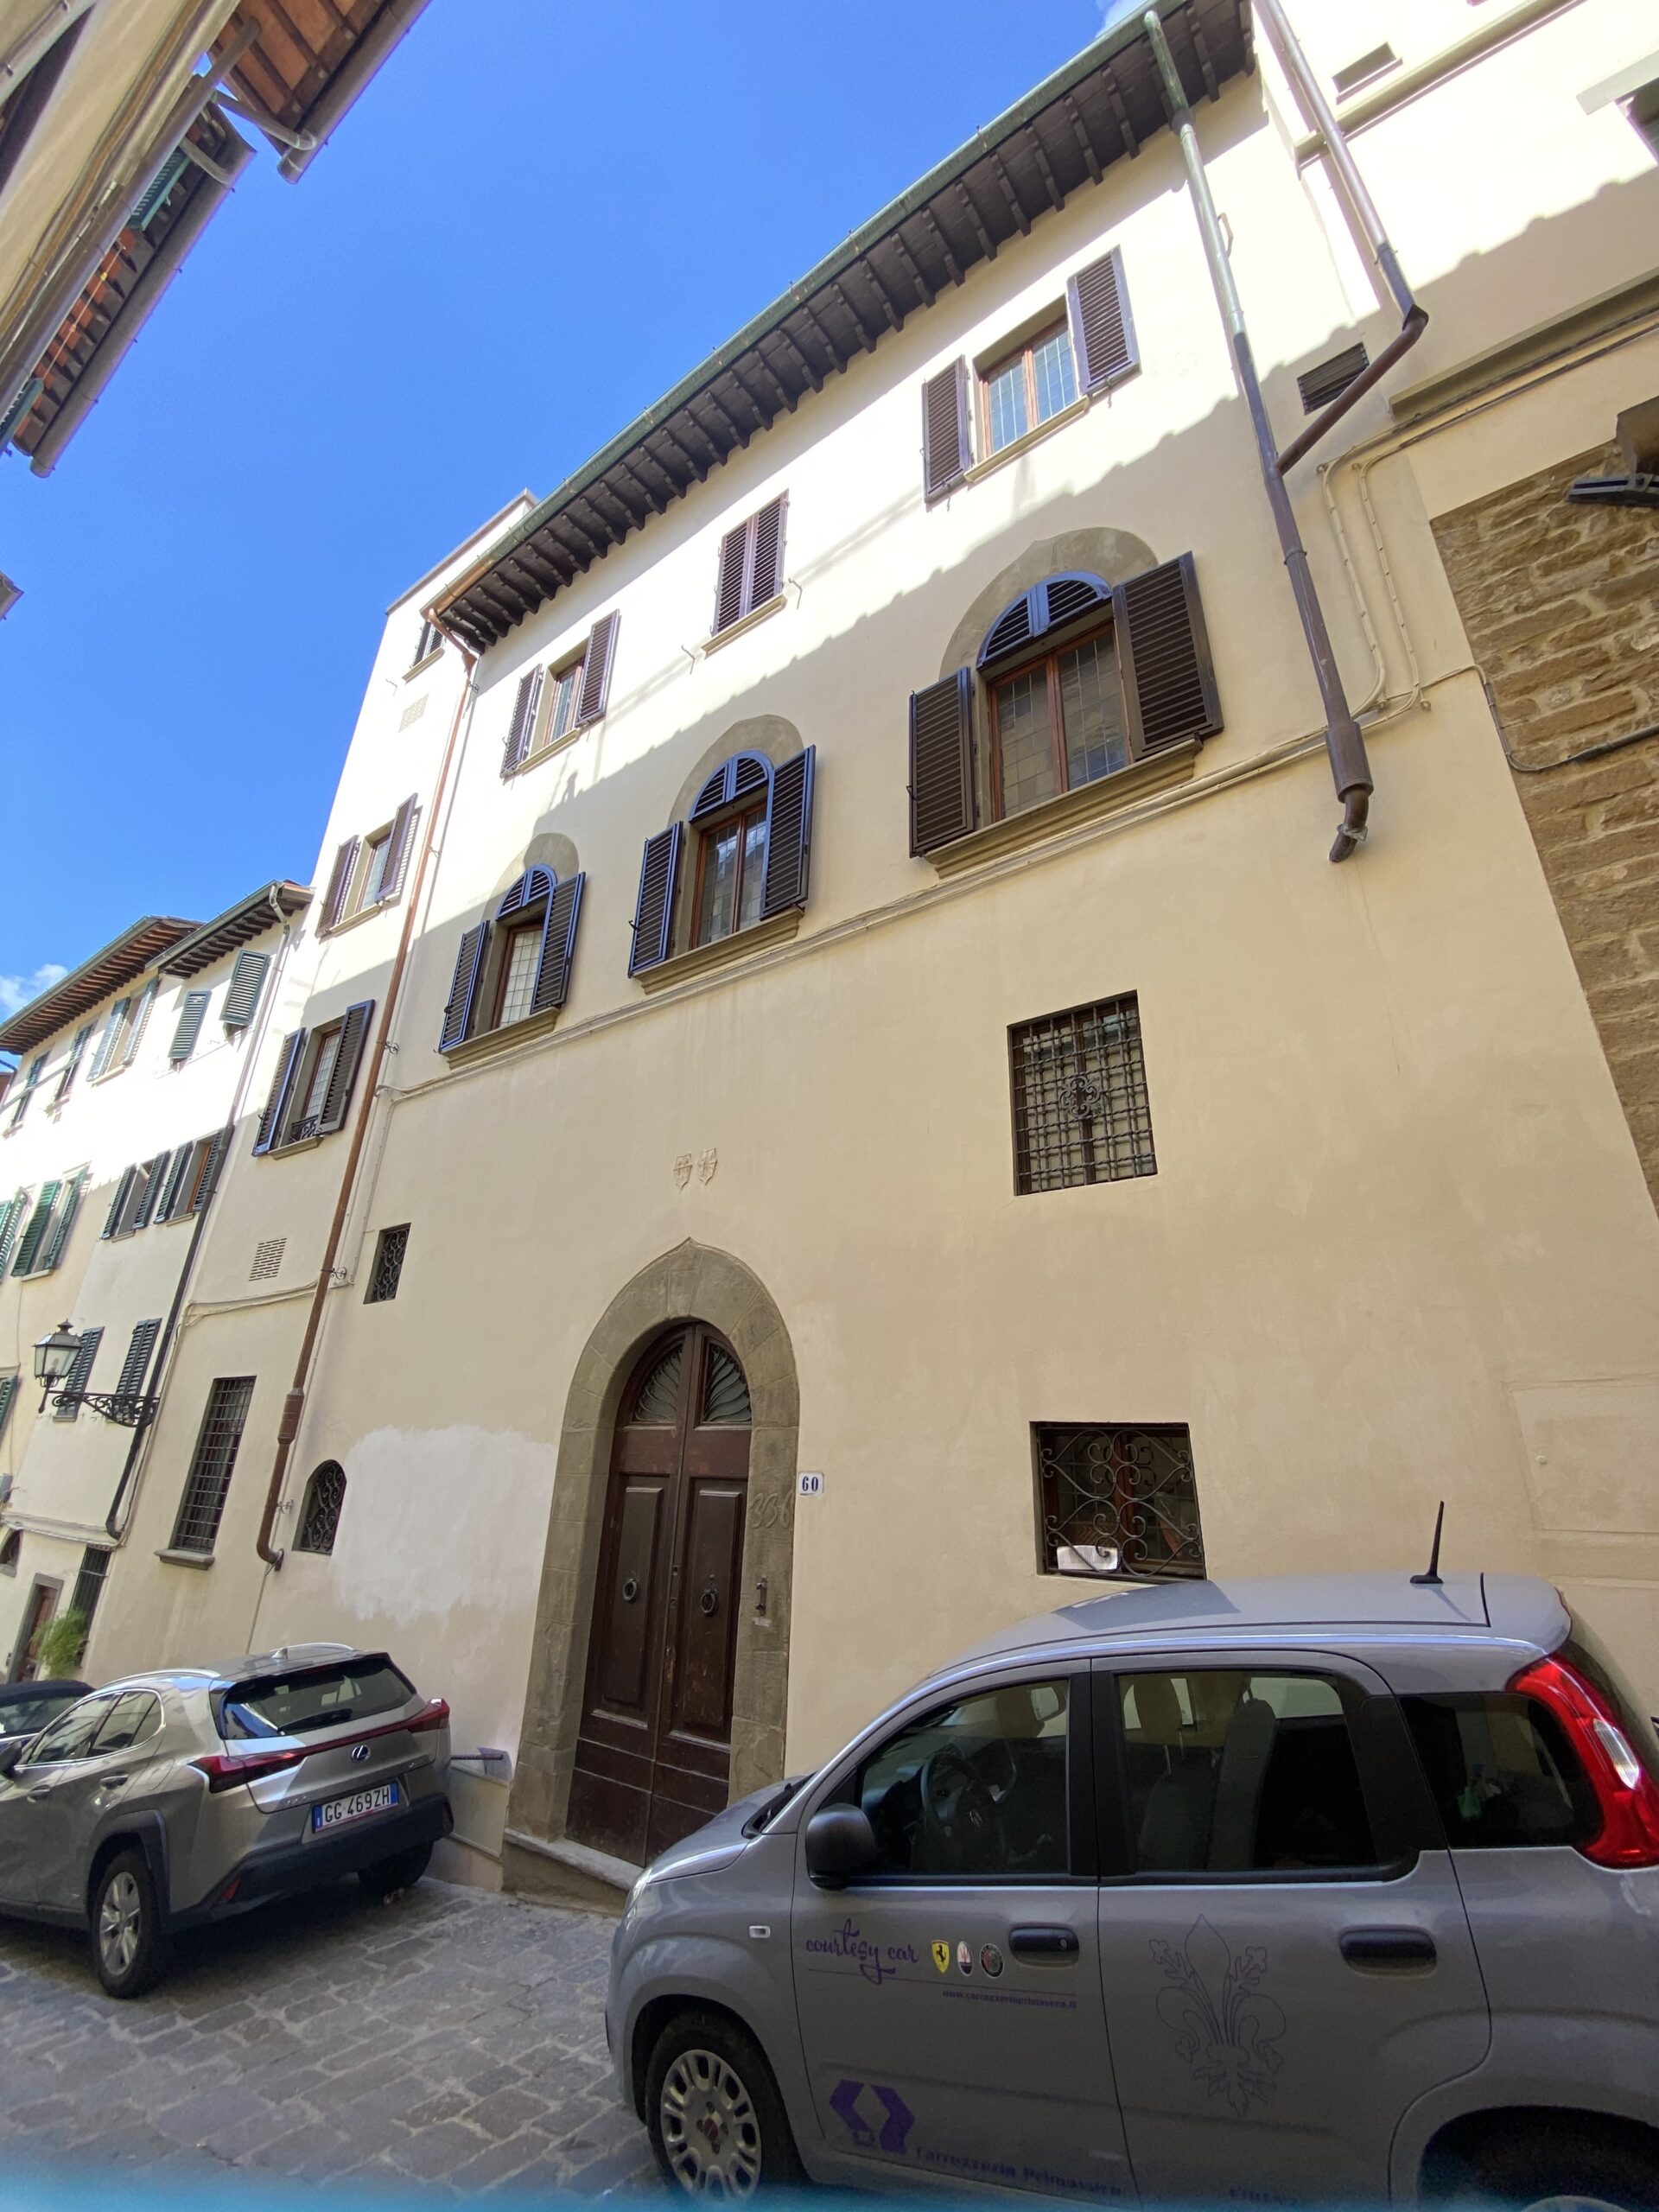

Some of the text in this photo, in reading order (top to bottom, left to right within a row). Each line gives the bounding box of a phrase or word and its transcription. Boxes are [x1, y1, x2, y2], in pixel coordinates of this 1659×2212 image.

[802, 1476, 819, 1491] 60
[325, 1802, 342, 1822] GG
[347, 1787, 390, 1815] 469ZH
[806, 1917, 920, 1985] courtesy car
